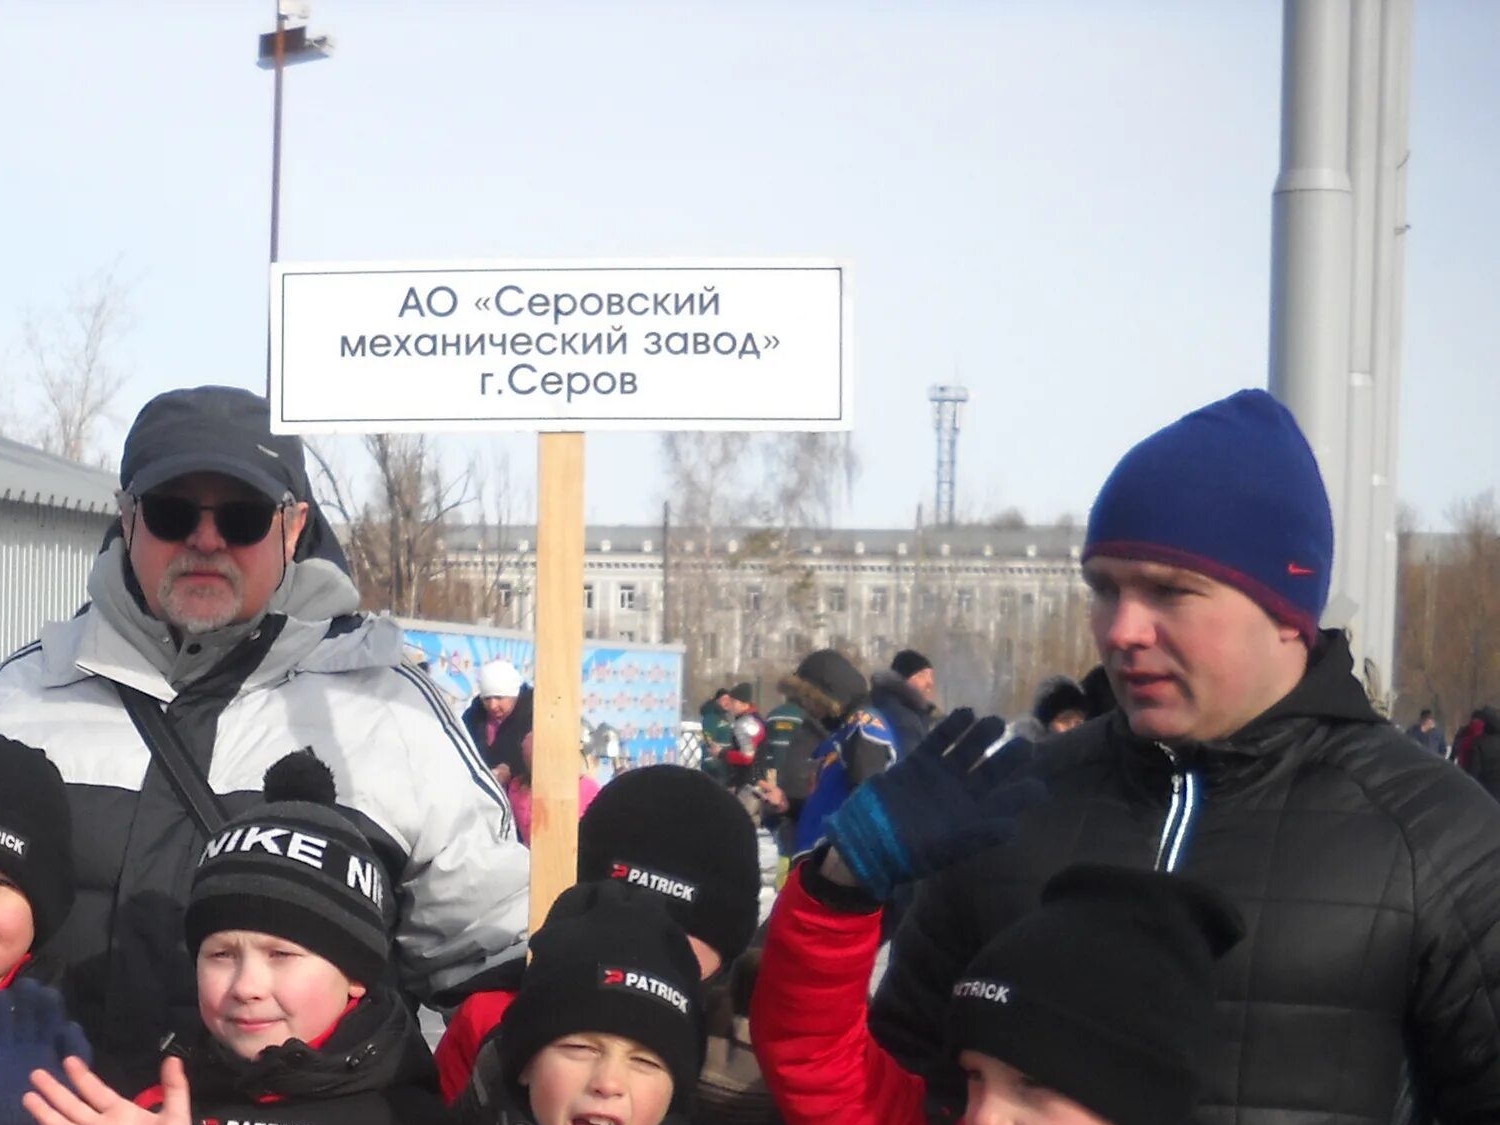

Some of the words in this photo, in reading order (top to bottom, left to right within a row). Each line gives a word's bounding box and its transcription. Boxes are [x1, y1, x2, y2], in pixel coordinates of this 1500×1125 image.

[398, 285, 459, 318] АО
[475, 284, 721, 324] «Серовский
[339, 325, 629, 358] механический
[643, 330, 781, 360] завод»
[479, 362, 639, 402] г.Серов
[198, 826, 328, 870] NIKE
[627, 868, 695, 902] PATRICK
[625, 972, 689, 1014] PATRICK
